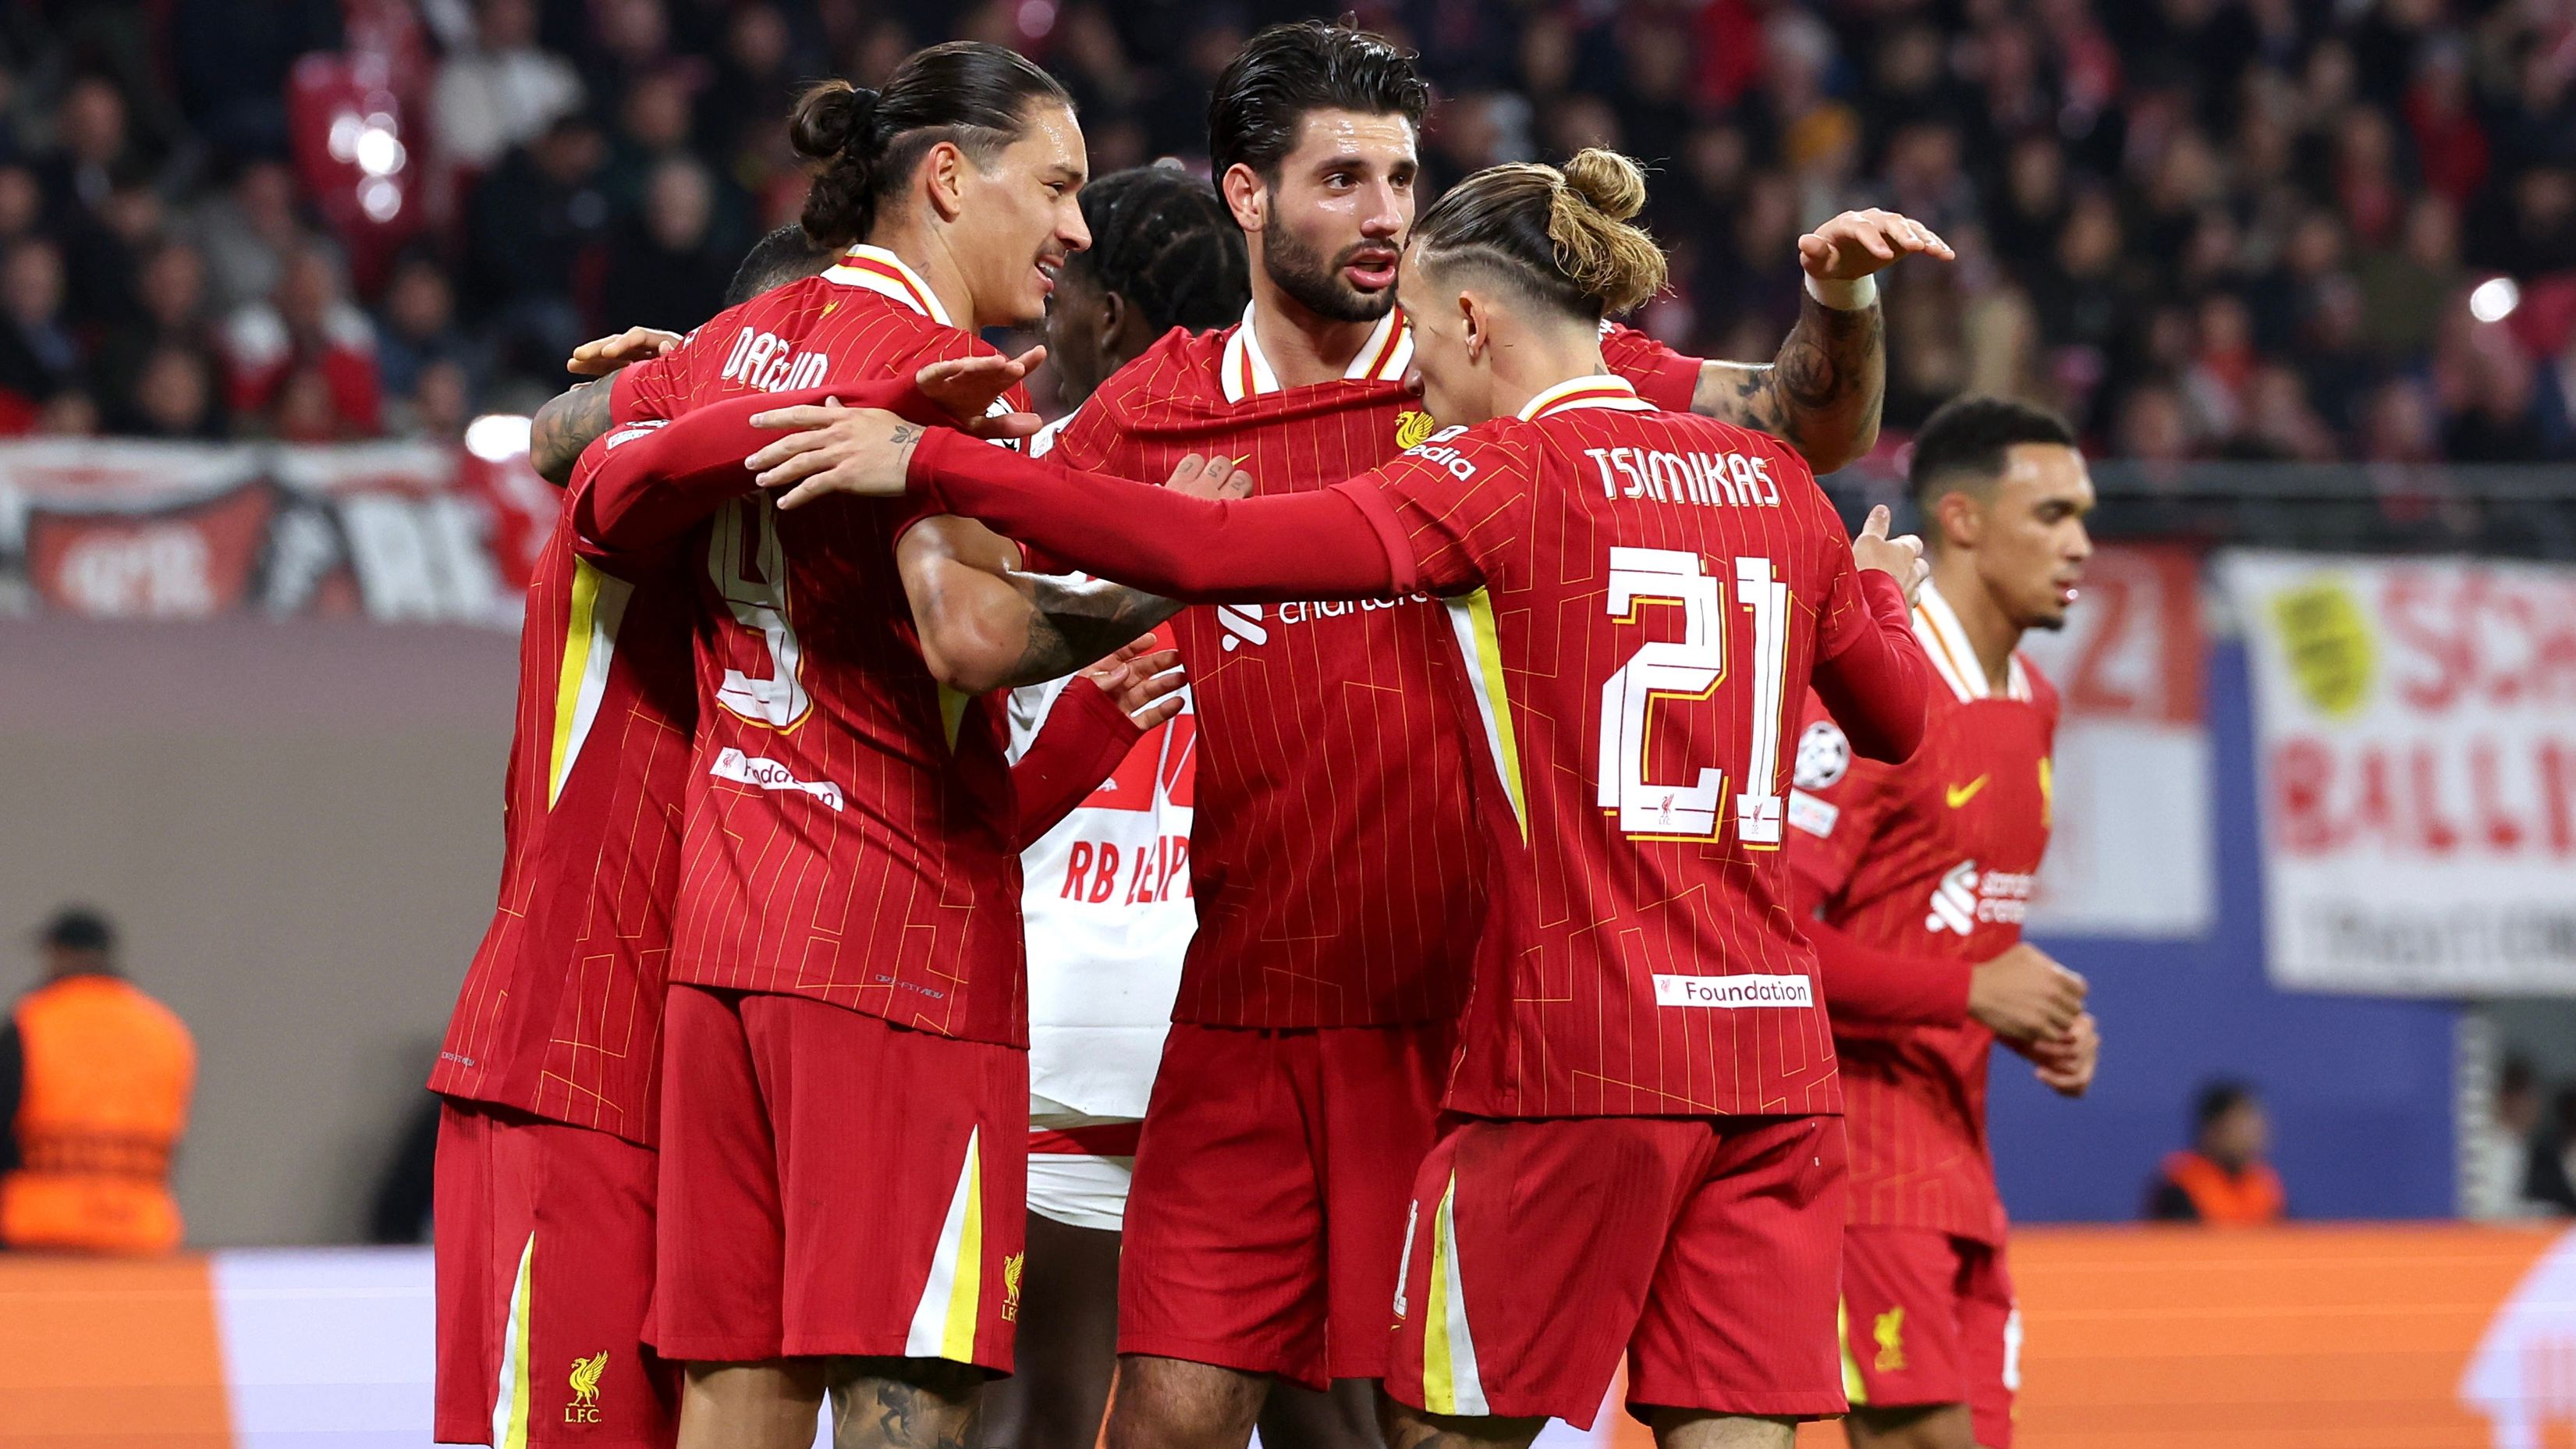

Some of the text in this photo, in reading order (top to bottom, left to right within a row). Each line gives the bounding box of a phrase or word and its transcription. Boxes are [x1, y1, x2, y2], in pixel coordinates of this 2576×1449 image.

[1584, 448, 1782, 507] TSIMIKAS
[1597, 546, 1789, 847] 21
[1059, 835, 1194, 907] RB LEIP
[1685, 980, 1807, 1001] Foundation
[565, 1408, 602, 1423] L.F.C.
